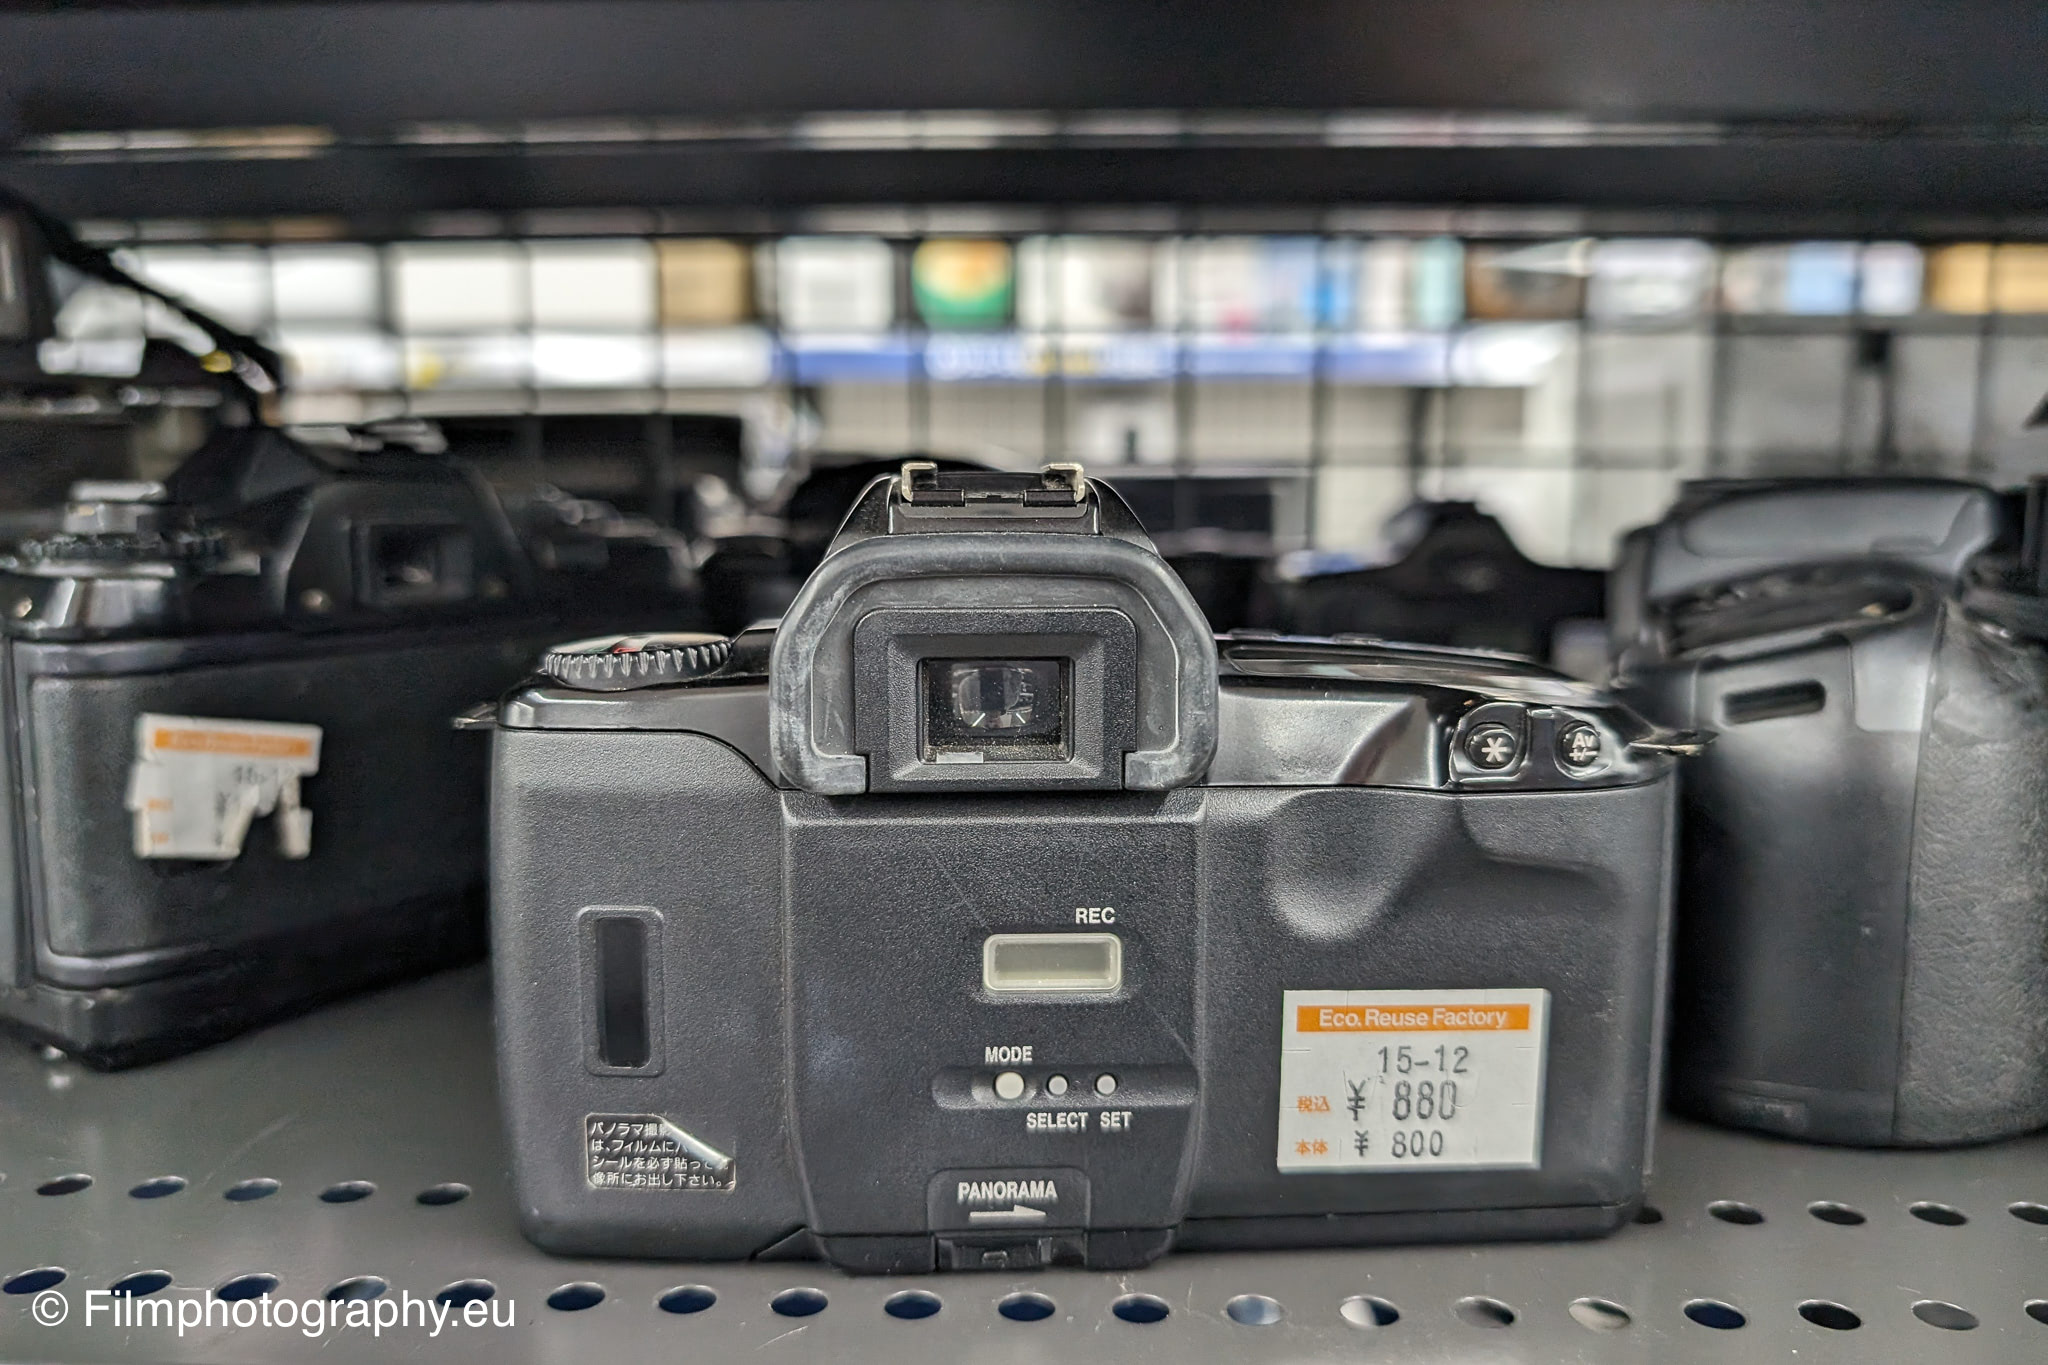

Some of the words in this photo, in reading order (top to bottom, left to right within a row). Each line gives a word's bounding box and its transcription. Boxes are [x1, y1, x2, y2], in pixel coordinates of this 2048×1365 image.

[1075, 907, 1116, 924] REC
[1319, 1009, 1361, 1028] Eco.
[1364, 1008, 1429, 1027] Reuse
[1432, 1007, 1508, 1029] Factory
[985, 1046, 1033, 1063] MODE
[1377, 1044, 1470, 1074] 15-12
[1297, 1095, 1331, 1113] 税込
[1346, 1079, 1367, 1122] ¥
[1391, 1080, 1457, 1121] 880
[1026, 1111, 1089, 1130] SELECT
[1099, 1110, 1132, 1130] SET
[1295, 1138, 1329, 1156] 本体
[1354, 1129, 1369, 1157] ¥
[1391, 1129, 1445, 1159] 800
[957, 1180, 1058, 1201] PANORAMA
